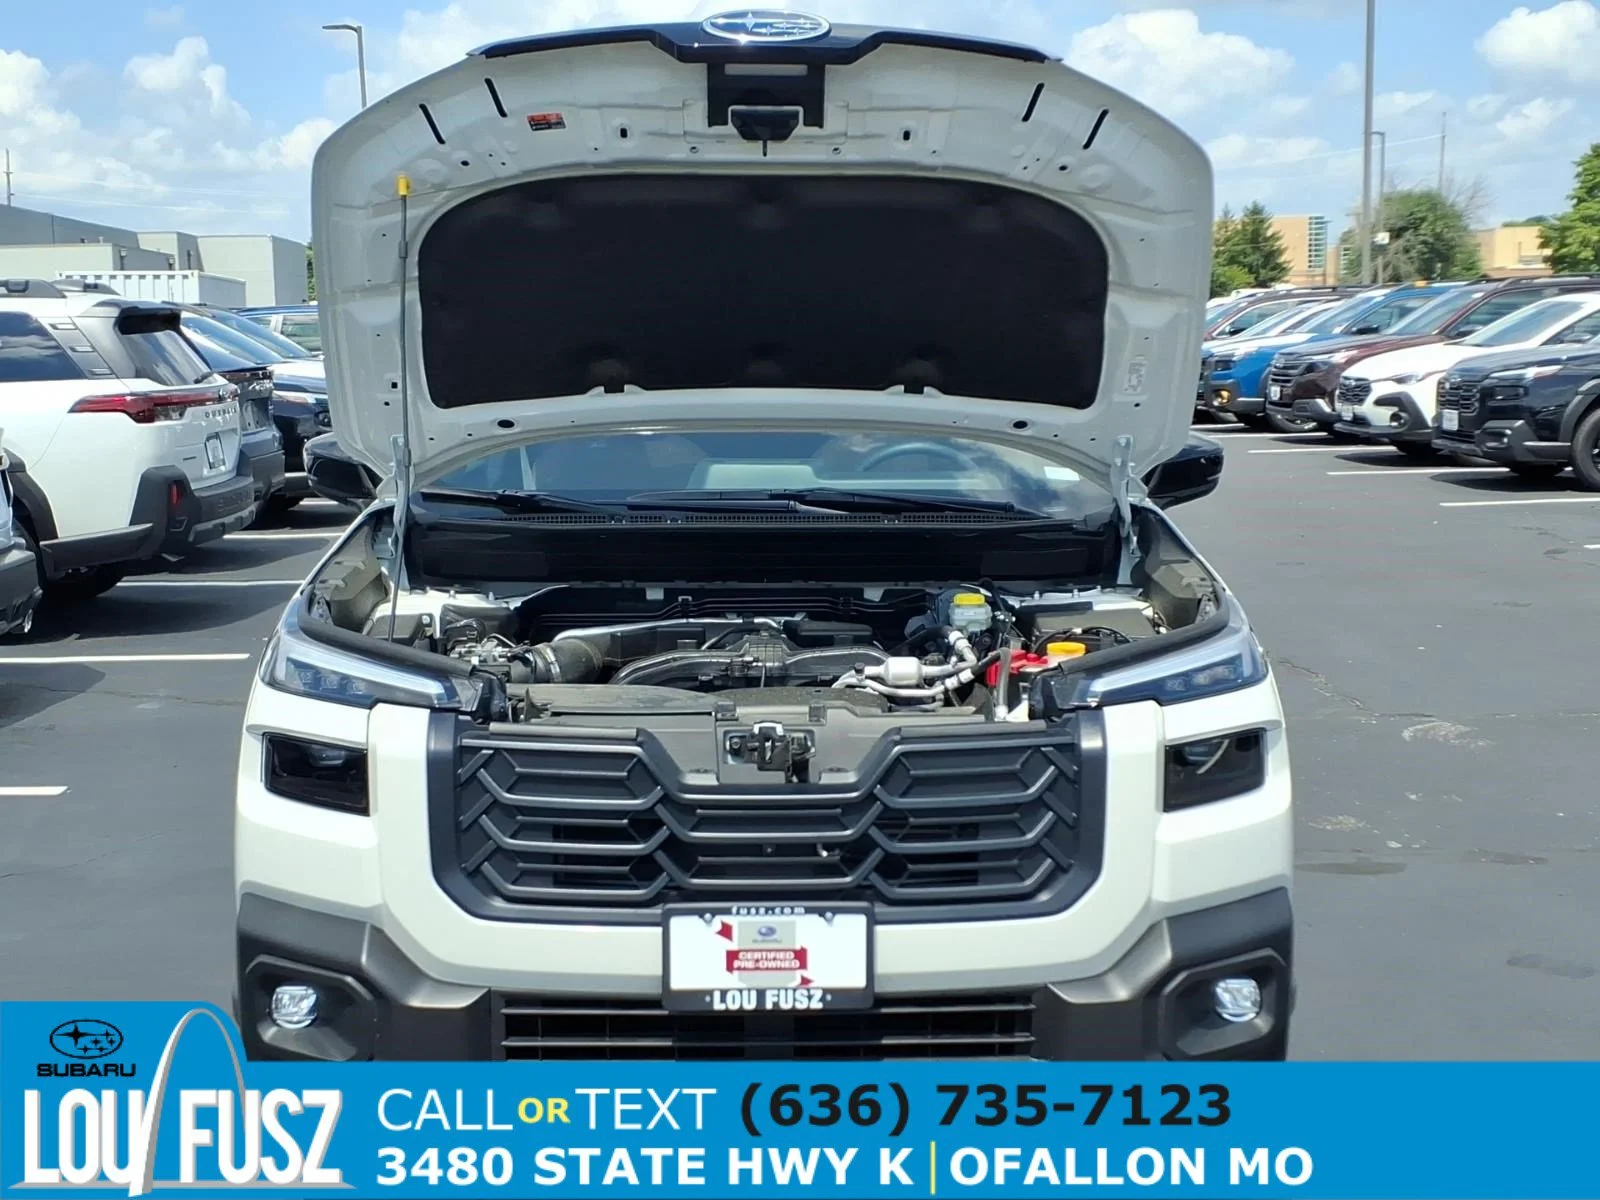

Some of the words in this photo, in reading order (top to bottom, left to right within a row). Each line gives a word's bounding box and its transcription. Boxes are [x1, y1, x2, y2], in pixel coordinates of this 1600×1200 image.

[738, 951, 795, 960] CERTIFIED
[733, 960, 800, 969] PRE-OWNED
[713, 990, 757, 1010] LOU
[765, 989, 823, 1010] FUSZ
